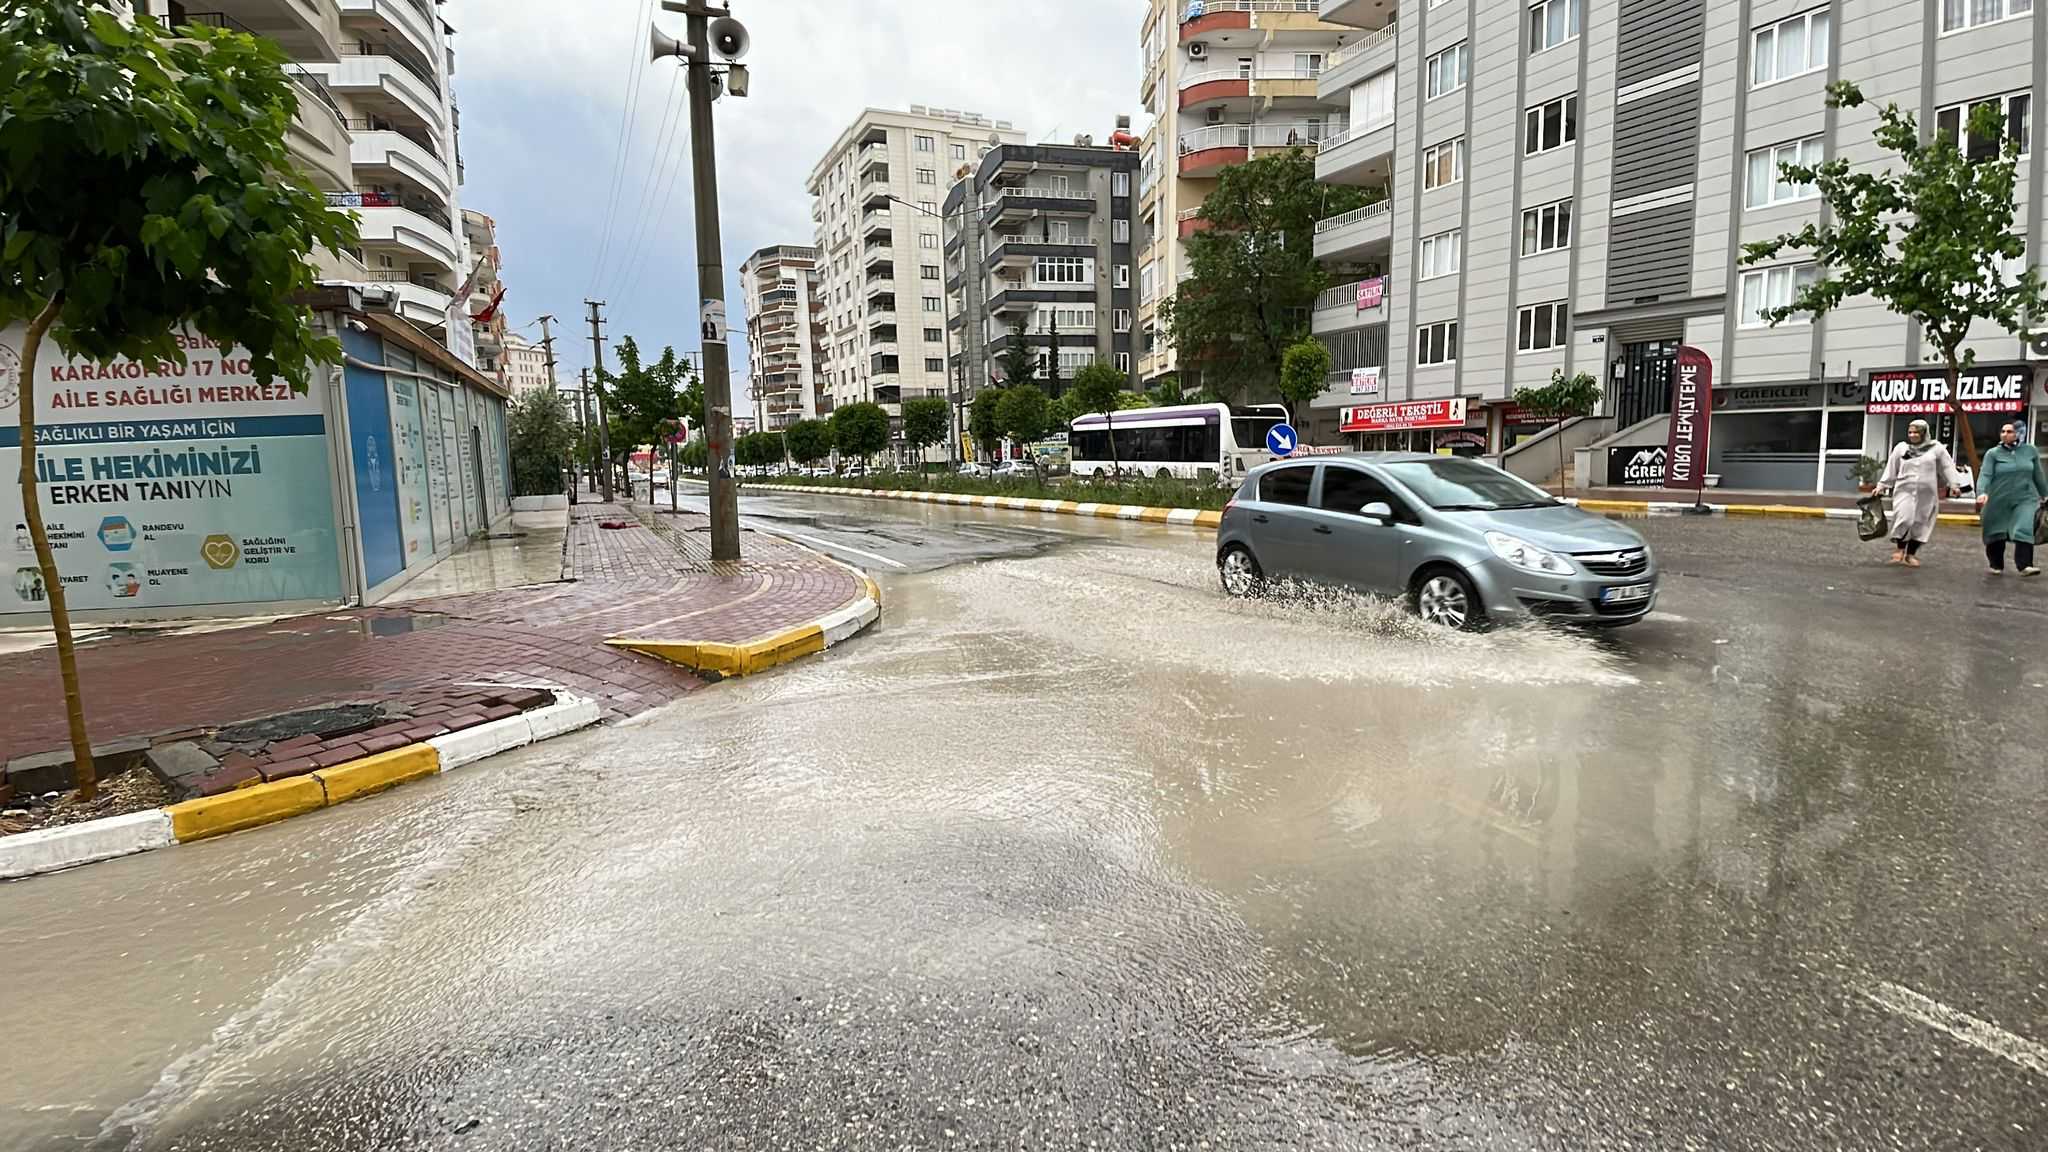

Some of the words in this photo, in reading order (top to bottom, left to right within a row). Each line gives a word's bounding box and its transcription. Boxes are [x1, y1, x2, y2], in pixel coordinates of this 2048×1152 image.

[192, 359, 213, 377] 17
[1871, 379, 1917, 402] KURU
[1921, 371, 2023, 401] TEMİZLEME
[52, 388, 99, 409] AİLE
[105, 385, 192, 407] SAĞLIĞI
[1357, 404, 1398, 420] DEĞERLİ
[1399, 401, 1444, 416] TEKSTİL
[108, 423, 136, 439] BİR
[140, 422, 197, 439] YAŞAM
[202, 419, 236, 437] İÇİN
[18, 452, 86, 484] İLE
[91, 444, 262, 481] HEKİMİNİZİ
[50, 483, 129, 505] ERKEN
[135, 479, 232, 501] TANIYIN
[46, 522, 65, 531] AİLE
[142, 523, 185, 532] RANDEVU
[144, 533, 157, 541] AL
[242, 536, 287, 546] SAĞLIĞINI
[243, 546, 282, 555] GELİŞTİR
[284, 546, 296, 554] VE
[244, 556, 270, 564] KORU
[147, 567, 189, 577] MUAYENE
[60, 575, 89, 584] İYARET
[148, 578, 161, 586] OL
